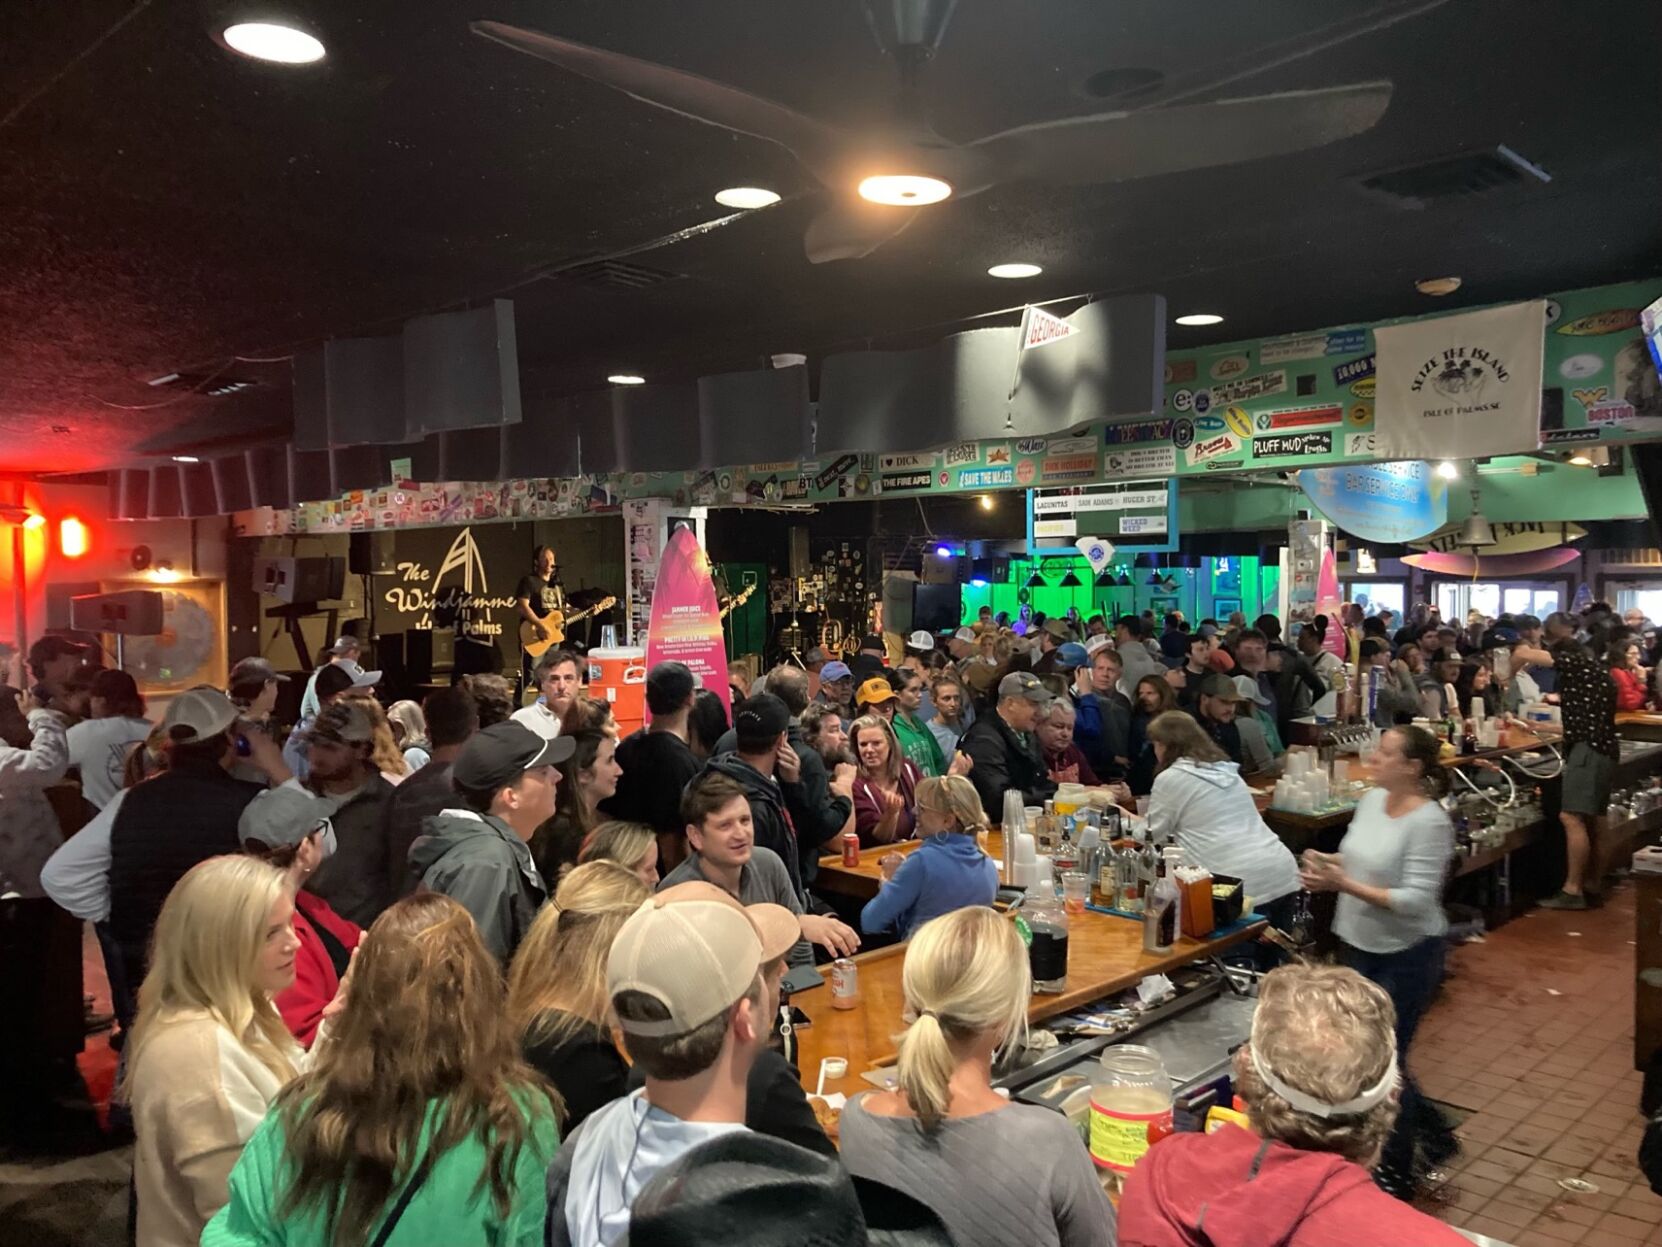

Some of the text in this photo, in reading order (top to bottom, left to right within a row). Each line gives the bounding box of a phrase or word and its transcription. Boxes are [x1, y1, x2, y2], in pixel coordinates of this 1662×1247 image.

[1030, 314, 1070, 344] GEORGIA
[1411, 347, 1510, 393] SEIZE THE ISLAND
[1423, 409, 1443, 418] ISLE
[1444, 407, 1454, 416] OF
[1588, 405, 1634, 422] BOSTON
[1254, 439, 1280, 454] PLUFF
[1282, 437, 1301, 452] MUD
[896, 456, 919, 466] DICK
[883, 475, 931, 487] THE FIRE APES
[964, 472, 981, 486] SAVE
[981, 471, 993, 485] THE
[1037, 500, 1068, 509] LAGUNITAS
[1078, 498, 1113, 507] SAM ADAMS
[1123, 496, 1146, 504] HUGER
[1122, 518, 1148, 526] WICKED
[397, 562, 430, 581] The
[385, 587, 517, 617] Windjamme
[463, 619, 503, 635] Palms
